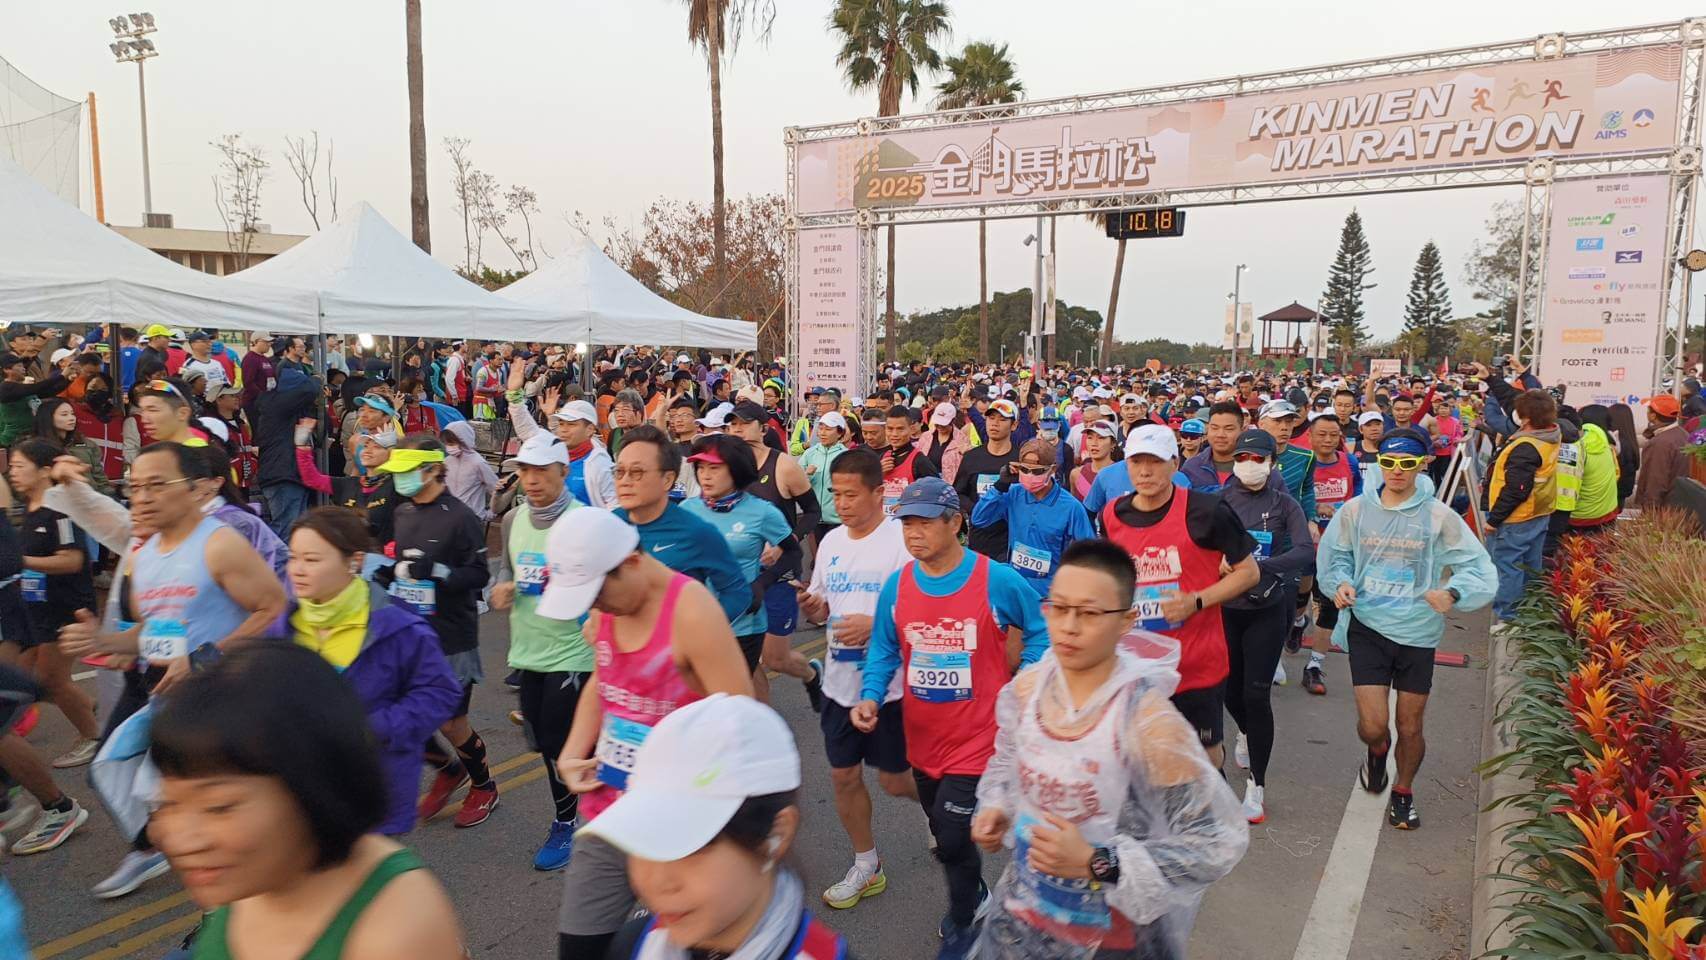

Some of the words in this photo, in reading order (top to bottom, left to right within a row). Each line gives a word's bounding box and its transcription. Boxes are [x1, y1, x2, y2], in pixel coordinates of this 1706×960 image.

[1249, 84, 1456, 141] KINMEN
[1271, 110, 1583, 171] MARATHON
[1594, 128, 1628, 140] AIMS
[867, 174, 925, 199] 2025
[1561, 358, 1598, 367] FOOTER
[1016, 554, 1043, 571] 3870
[917, 670, 959, 686] 3920
